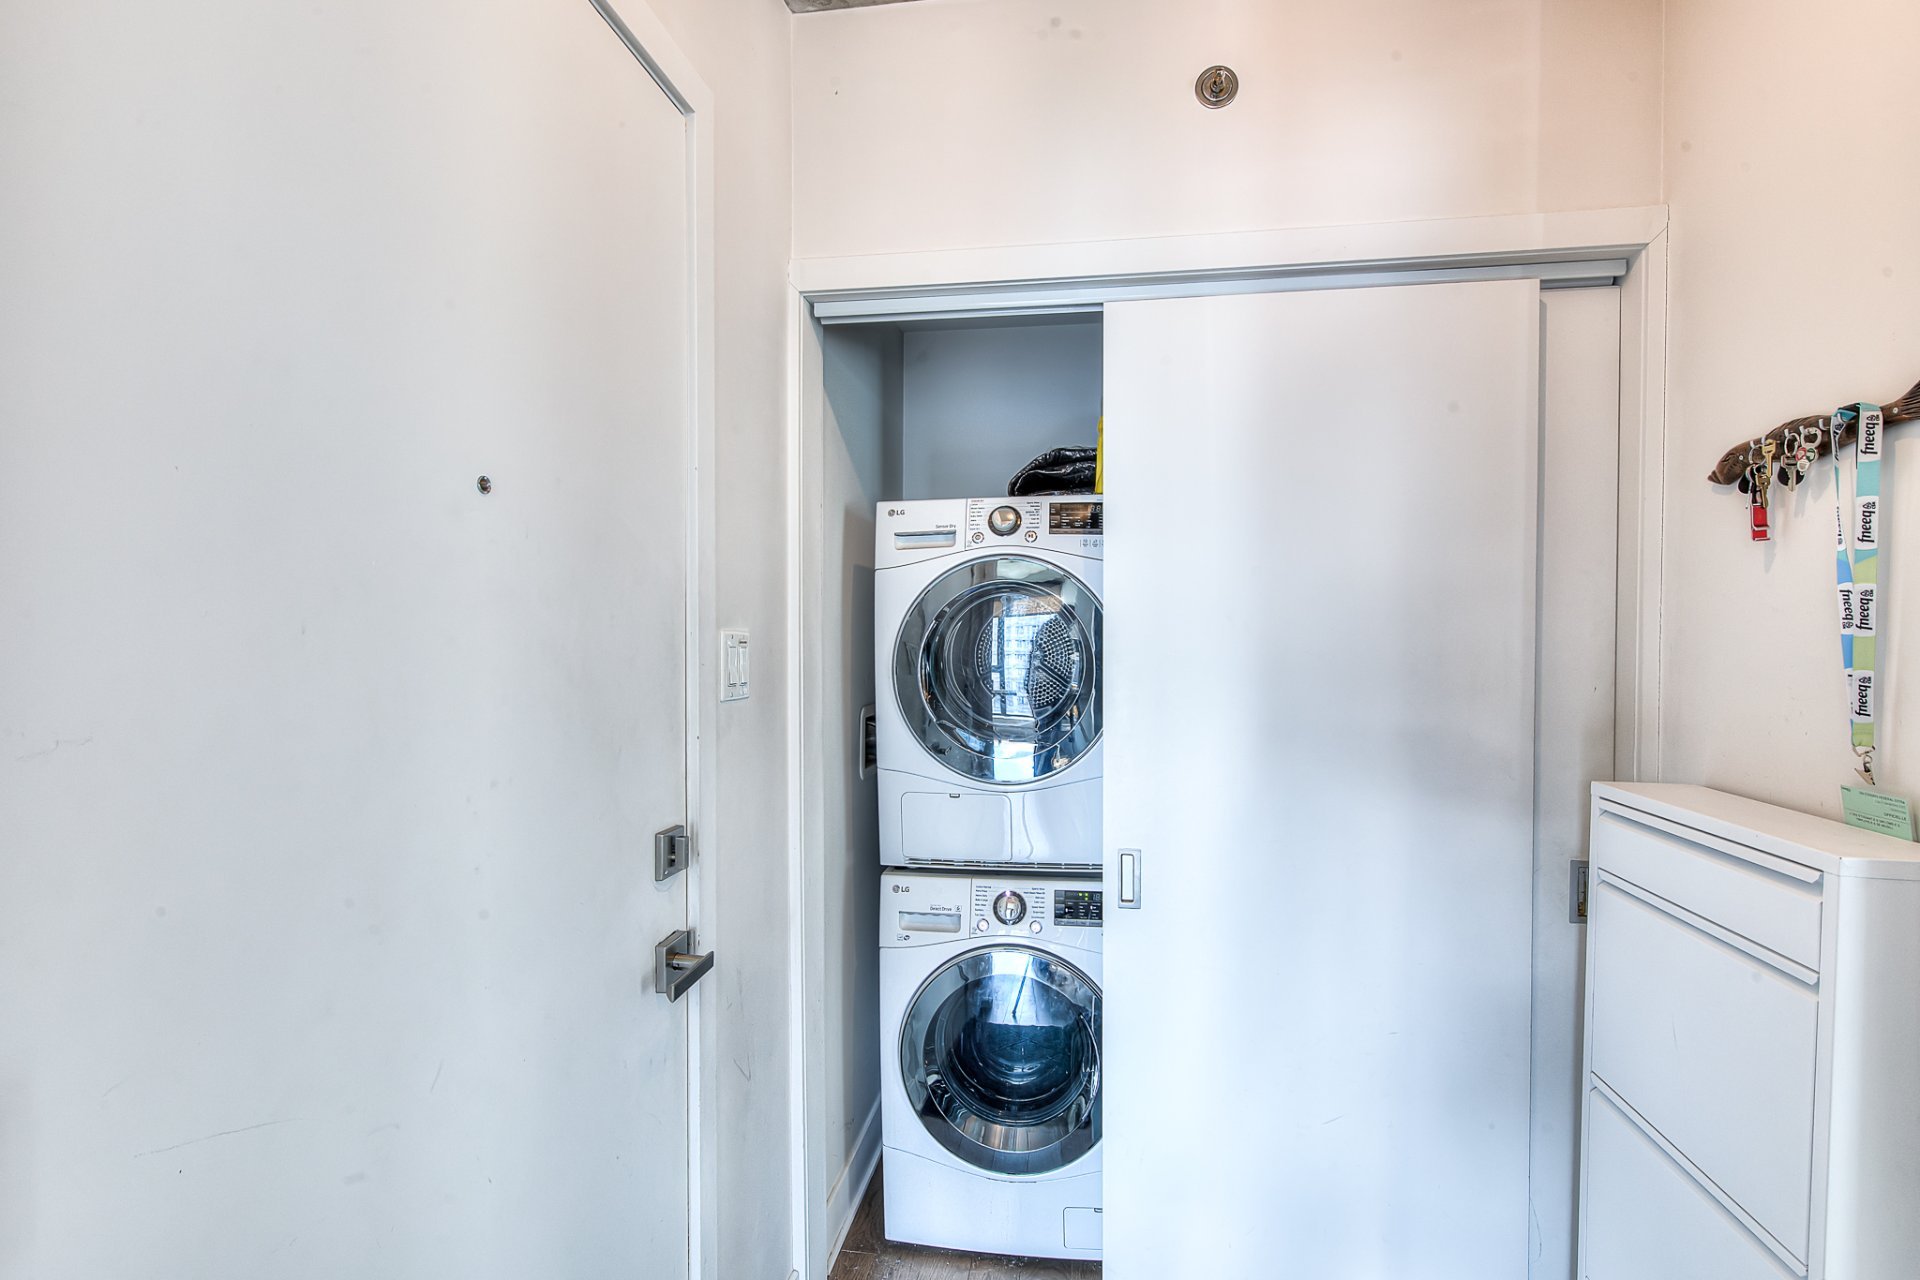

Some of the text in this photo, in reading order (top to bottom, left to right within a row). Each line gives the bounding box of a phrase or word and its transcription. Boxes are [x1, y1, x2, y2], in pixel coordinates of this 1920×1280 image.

[1860, 422, 1879, 455] fneeq
[1857, 510, 1876, 543] fneeq
[1839, 589, 1854, 621] fneeq
[1855, 597, 1873, 630] fneeq
[1855, 684, 1871, 717] fneeq
